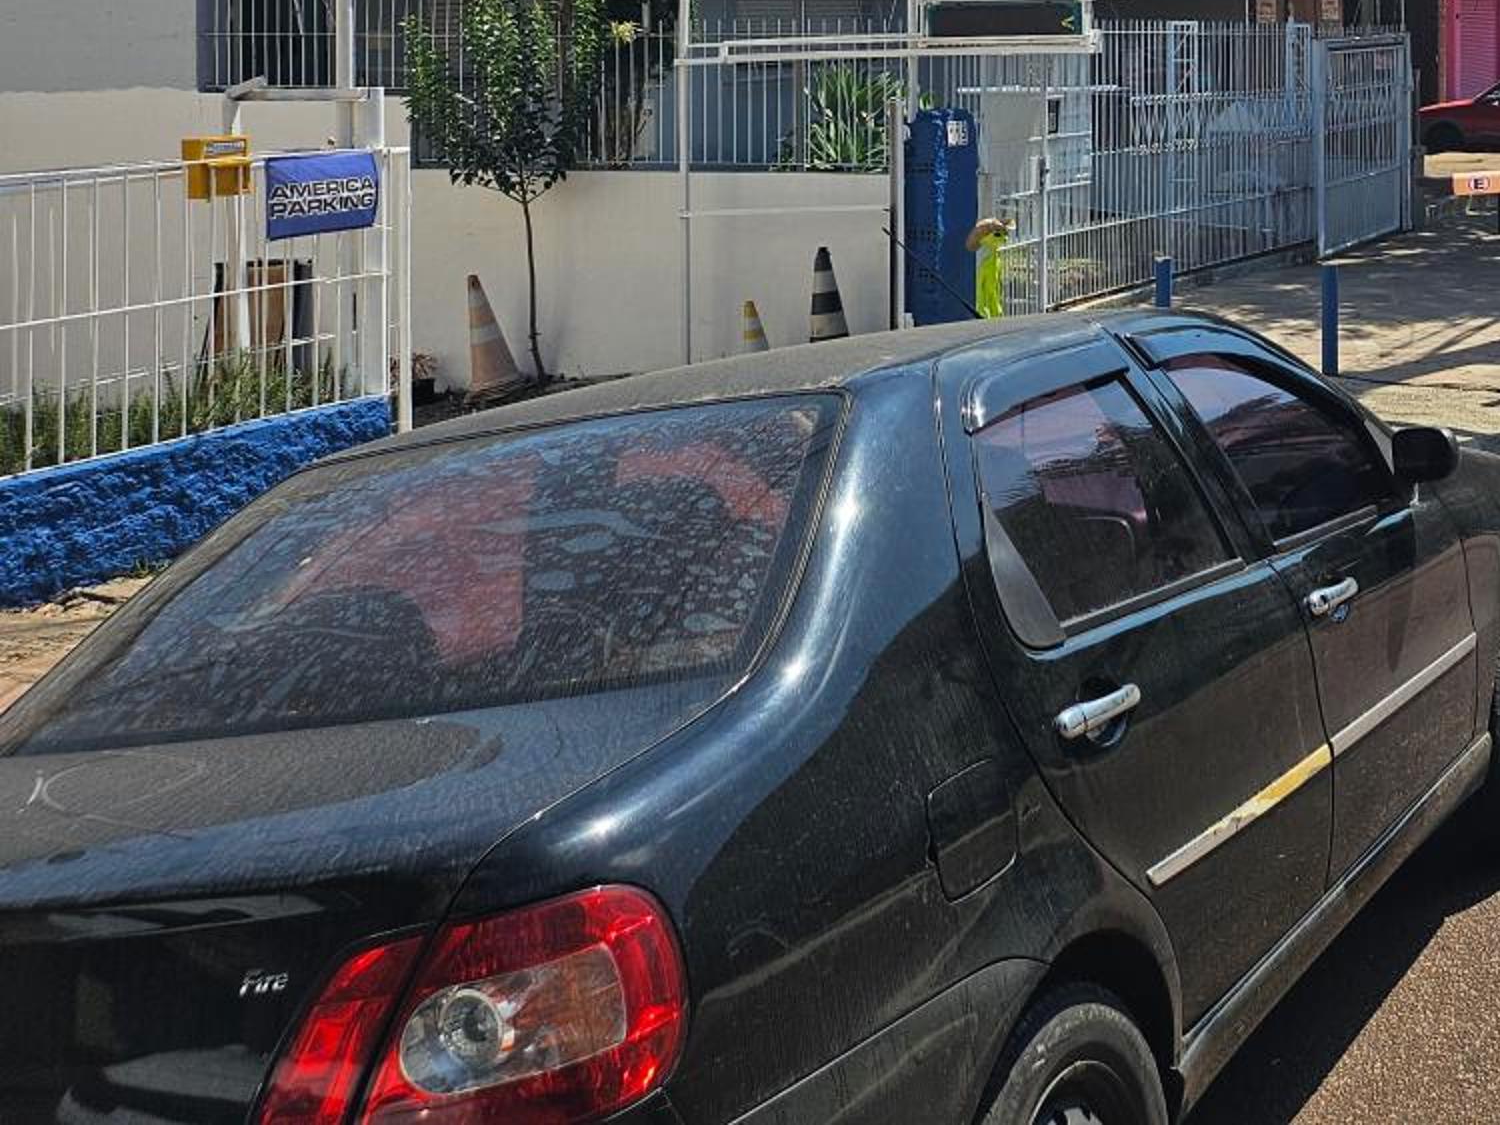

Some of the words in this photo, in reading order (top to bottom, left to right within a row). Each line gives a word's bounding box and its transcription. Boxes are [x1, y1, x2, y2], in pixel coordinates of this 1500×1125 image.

[272, 177, 374, 200] AMERICA
[1472, 178, 1484, 190] E
[270, 193, 374, 219] PARKING
[240, 970, 288, 996] Fire
